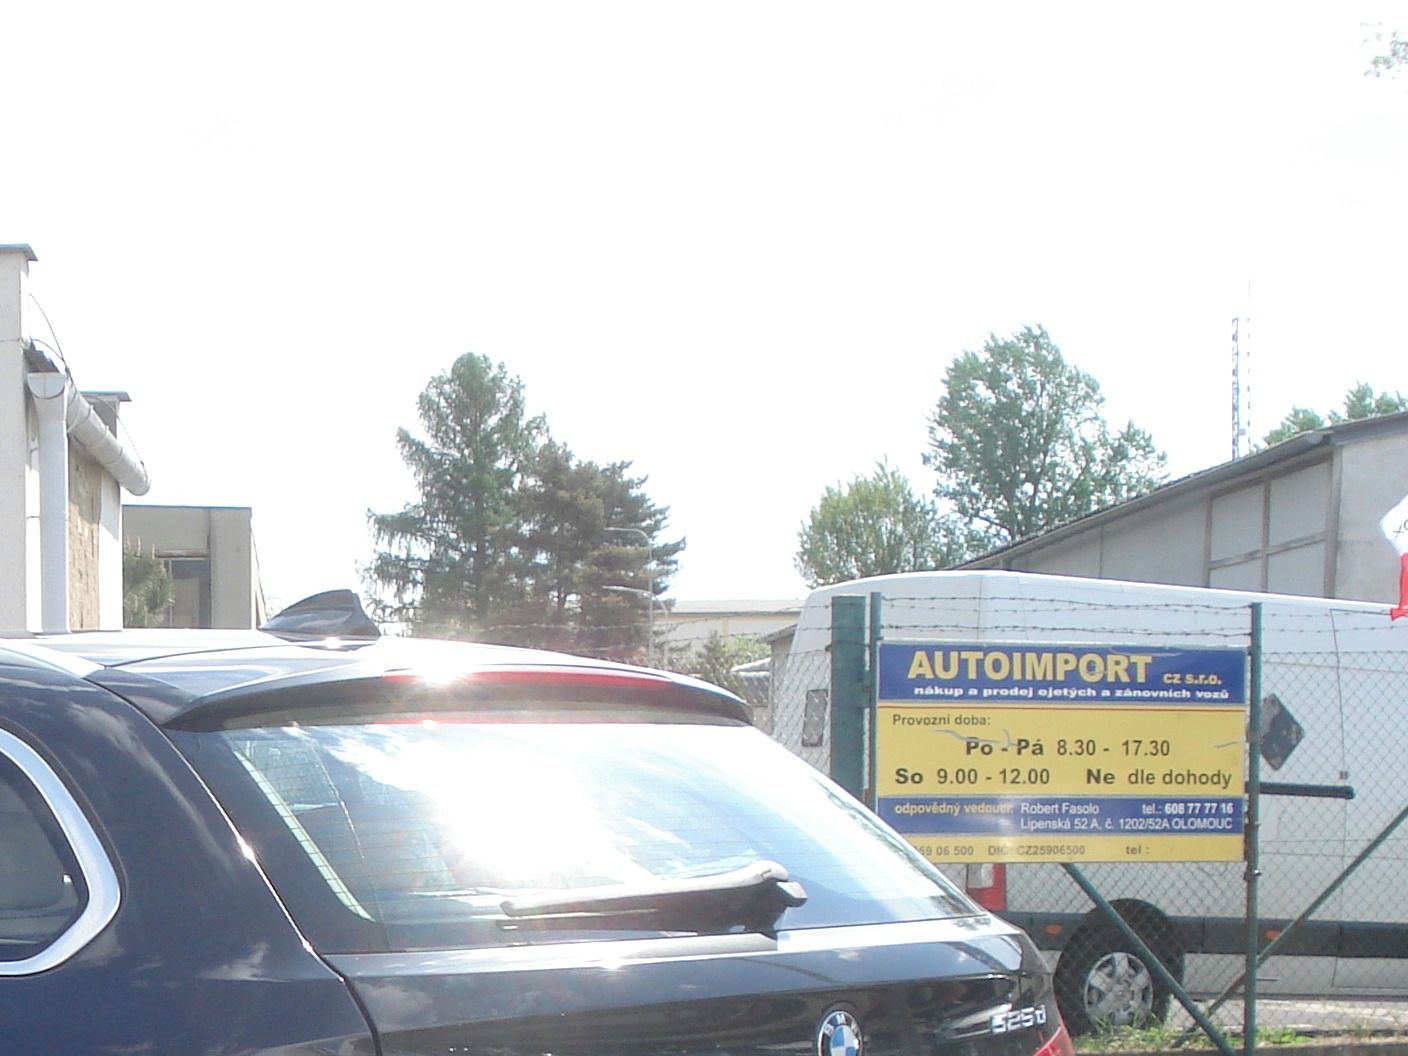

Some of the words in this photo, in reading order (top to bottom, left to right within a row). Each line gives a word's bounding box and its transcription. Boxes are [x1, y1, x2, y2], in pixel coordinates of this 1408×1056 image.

[907, 650, 1152, 683] AUTOIMPORT
[1185, 673, 1222, 685] s.r.o.
[914, 685, 964, 698] nákup
[968, 687, 978, 696] a
[983, 686, 1033, 699] prodej
[1038, 686, 1096, 699] ojetých
[1101, 688, 1111, 697] a
[1115, 687, 1191, 699] zánovních
[892, 713, 950, 726] Provozní
[954, 713, 991, 726] doba:
[966, 736, 993, 756] Po
[1017, 738, 1044, 756] Pá
[1057, 739, 1096, 756] 8.30
[1122, 739, 1170, 757] 17.30
[895, 767, 923, 785] So
[937, 767, 978, 785] 9.00
[999, 767, 1050, 785] 12.00
[1086, 768, 1115, 785] Ne
[1128, 768, 1155, 785] dle
[1162, 768, 1232, 790] dohody
[1020, 802, 1058, 815] Robert
[1062, 803, 1100, 815] Fasolo
[1164, 803, 1184, 815] 608
[1187, 803, 1202, 815] 77
[1203, 803, 1218, 815] 77
[1222, 803, 1234, 815] 16
[1020, 817, 1071, 831] Lipenská
[1074, 818, 1087, 830] 52
[1119, 818, 1170, 830] 1202/52A
[1172, 818, 1233, 830] OLOMOUC
[936, 845, 950, 856] 06
[954, 845, 974, 856] 500
[991, 1005, 1047, 1034] 525d
